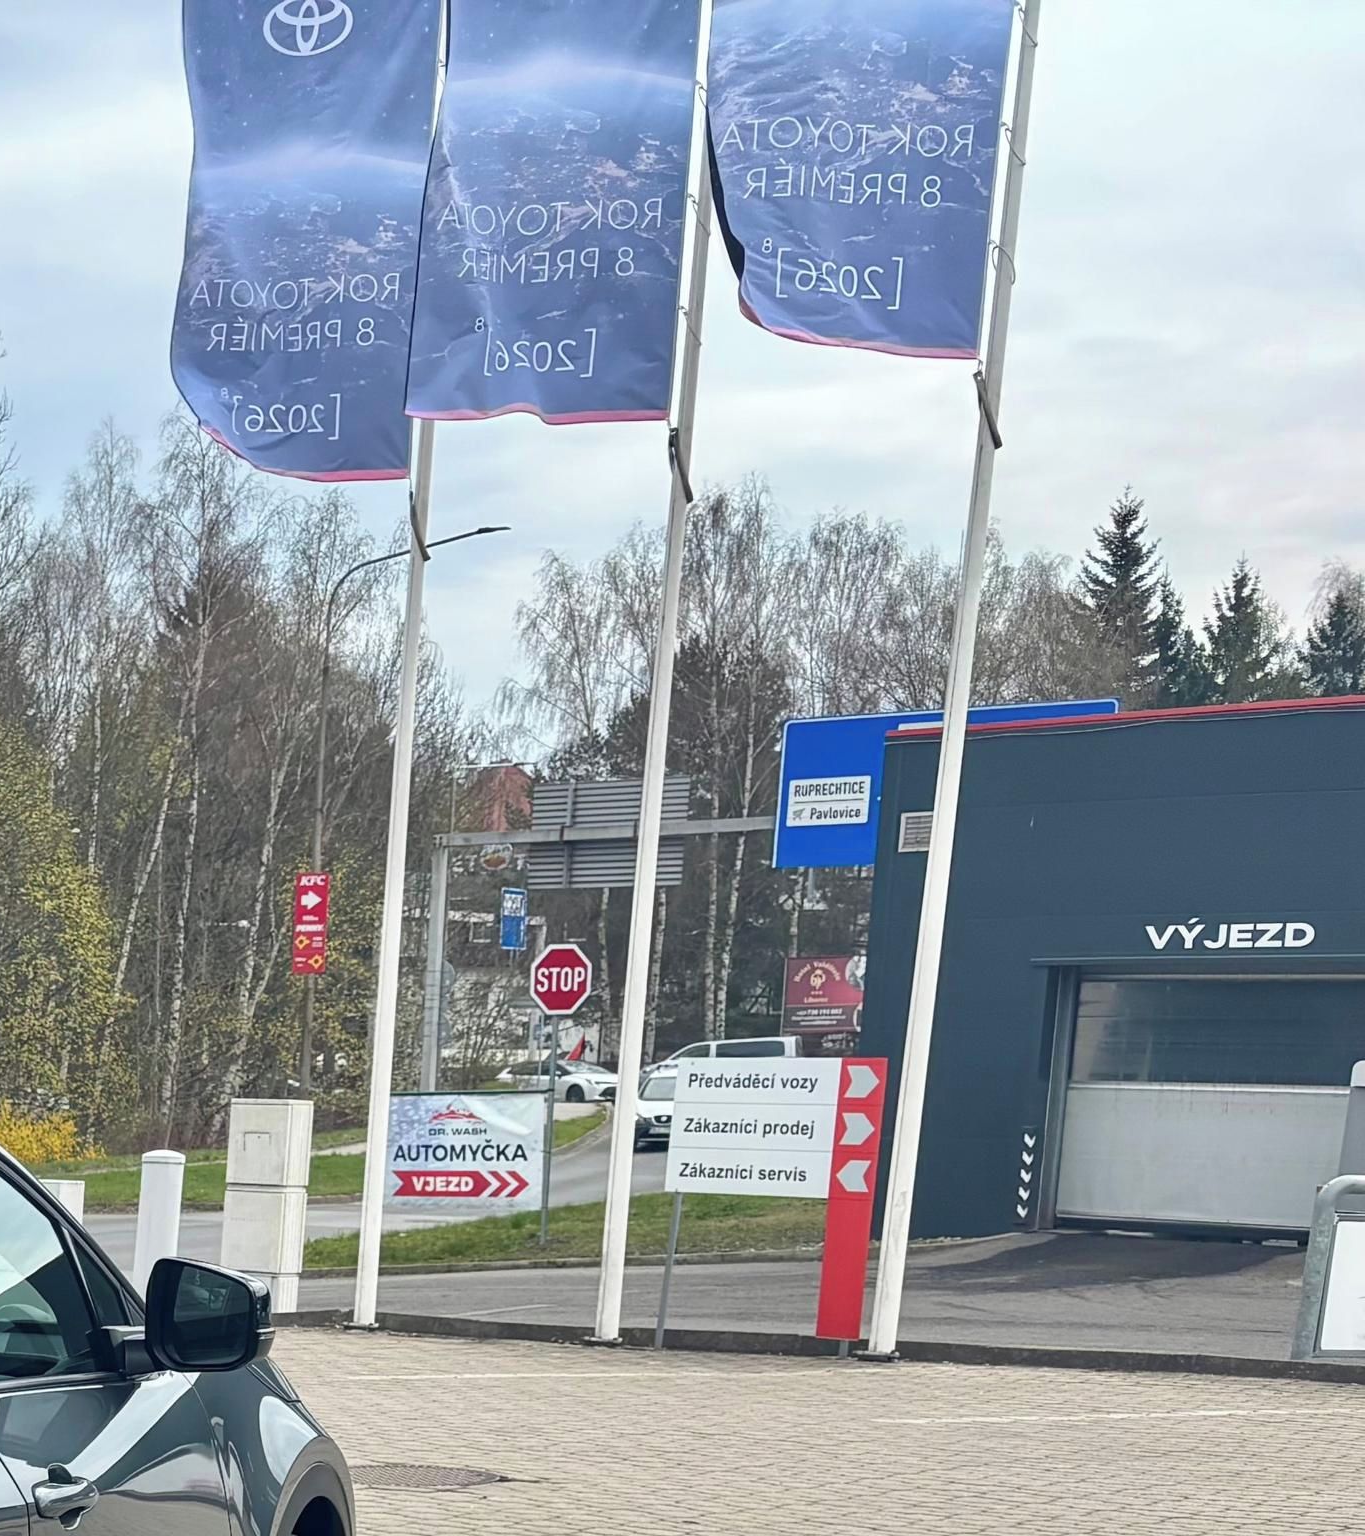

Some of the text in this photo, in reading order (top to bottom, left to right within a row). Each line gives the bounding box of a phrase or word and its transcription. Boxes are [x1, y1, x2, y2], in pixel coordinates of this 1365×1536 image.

[794, 781, 865, 797] RUPRECHTICE
[810, 806, 861, 820] Pavlovice
[300, 875, 326, 886] KFC
[1145, 917, 1315, 950] VÝJEZD
[536, 966, 585, 992] STOP
[688, 1072, 819, 1093] Předváděcí vozy
[429, 1127, 487, 1136] DR. WASH
[683, 1118, 815, 1144] Zákazníci prodej
[393, 1139, 528, 1162] AUTOMYČKA
[679, 1162, 807, 1182] Zákazníci servis
[411, 1176, 474, 1192] VJEZD
